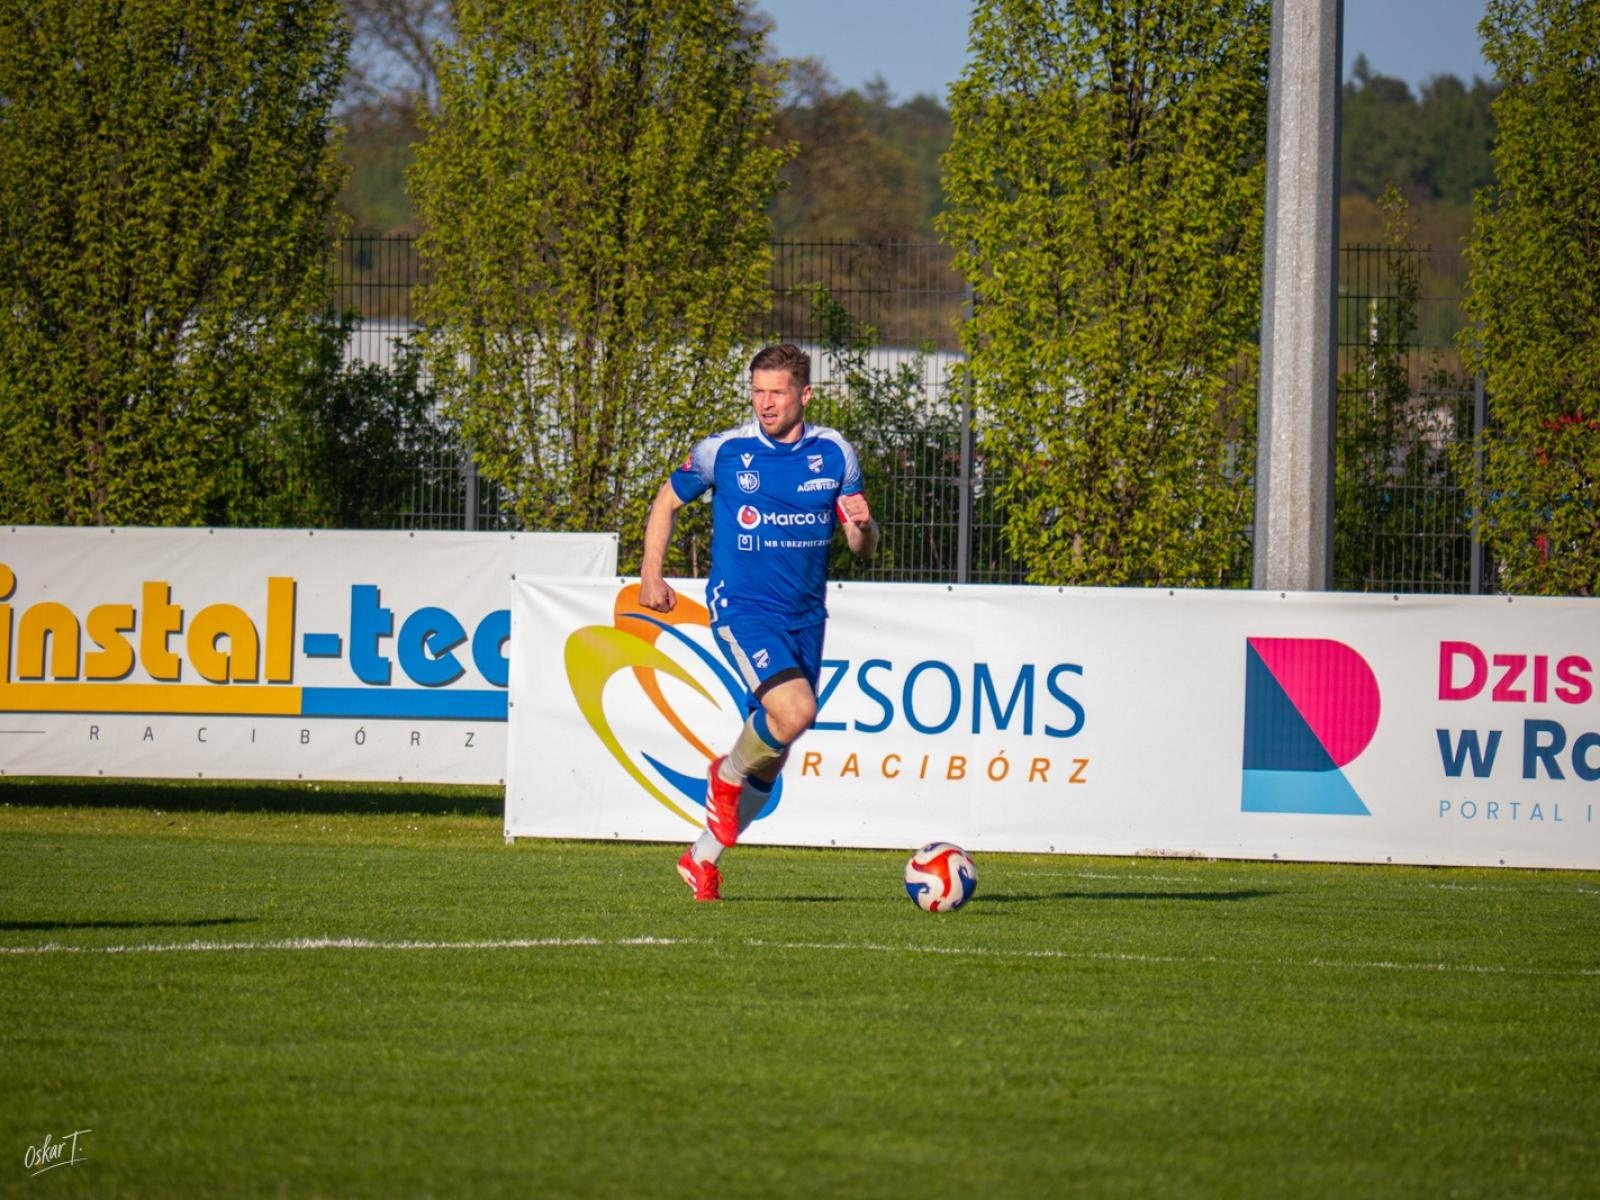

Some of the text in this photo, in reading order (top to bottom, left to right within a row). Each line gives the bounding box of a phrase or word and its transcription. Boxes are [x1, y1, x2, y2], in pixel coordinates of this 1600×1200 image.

[764, 540, 778, 548] MB
[809, 658, 1086, 738] ZSOMS
[89, 725, 475, 748] RACIBÓRZ
[801, 750, 1089, 784] RACIBÓRZ
[1439, 800, 1563, 822] PORTAL
